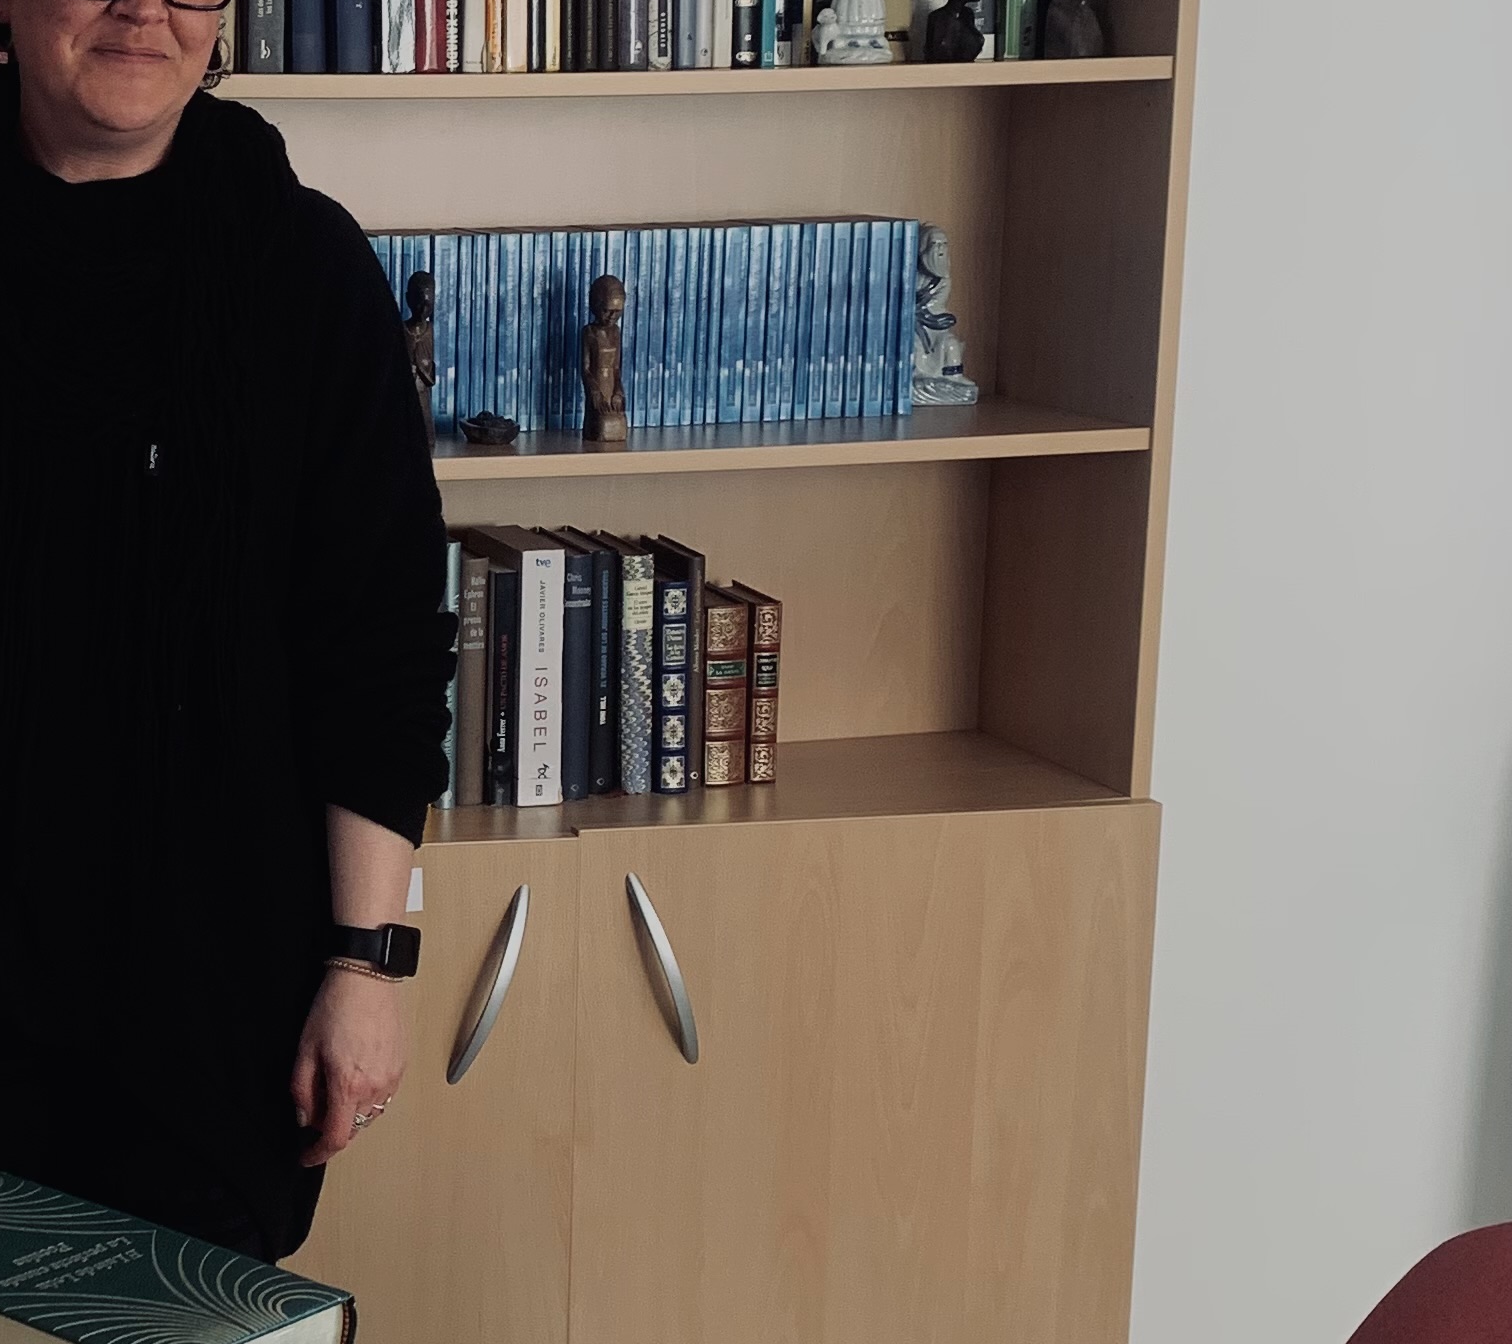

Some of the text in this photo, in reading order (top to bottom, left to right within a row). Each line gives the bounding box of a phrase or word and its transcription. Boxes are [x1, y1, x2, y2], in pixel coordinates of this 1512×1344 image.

[446, 1, 458, 16] DE
[536, 558, 551, 568] tve
[538, 611, 546, 654] OLIVARES
[533, 667, 548, 752] ISABEL
[599, 695, 607, 725] TONI HILL
[496, 718, 507, 753] Anna Ferrer
[106, 1236, 132, 1248] La
